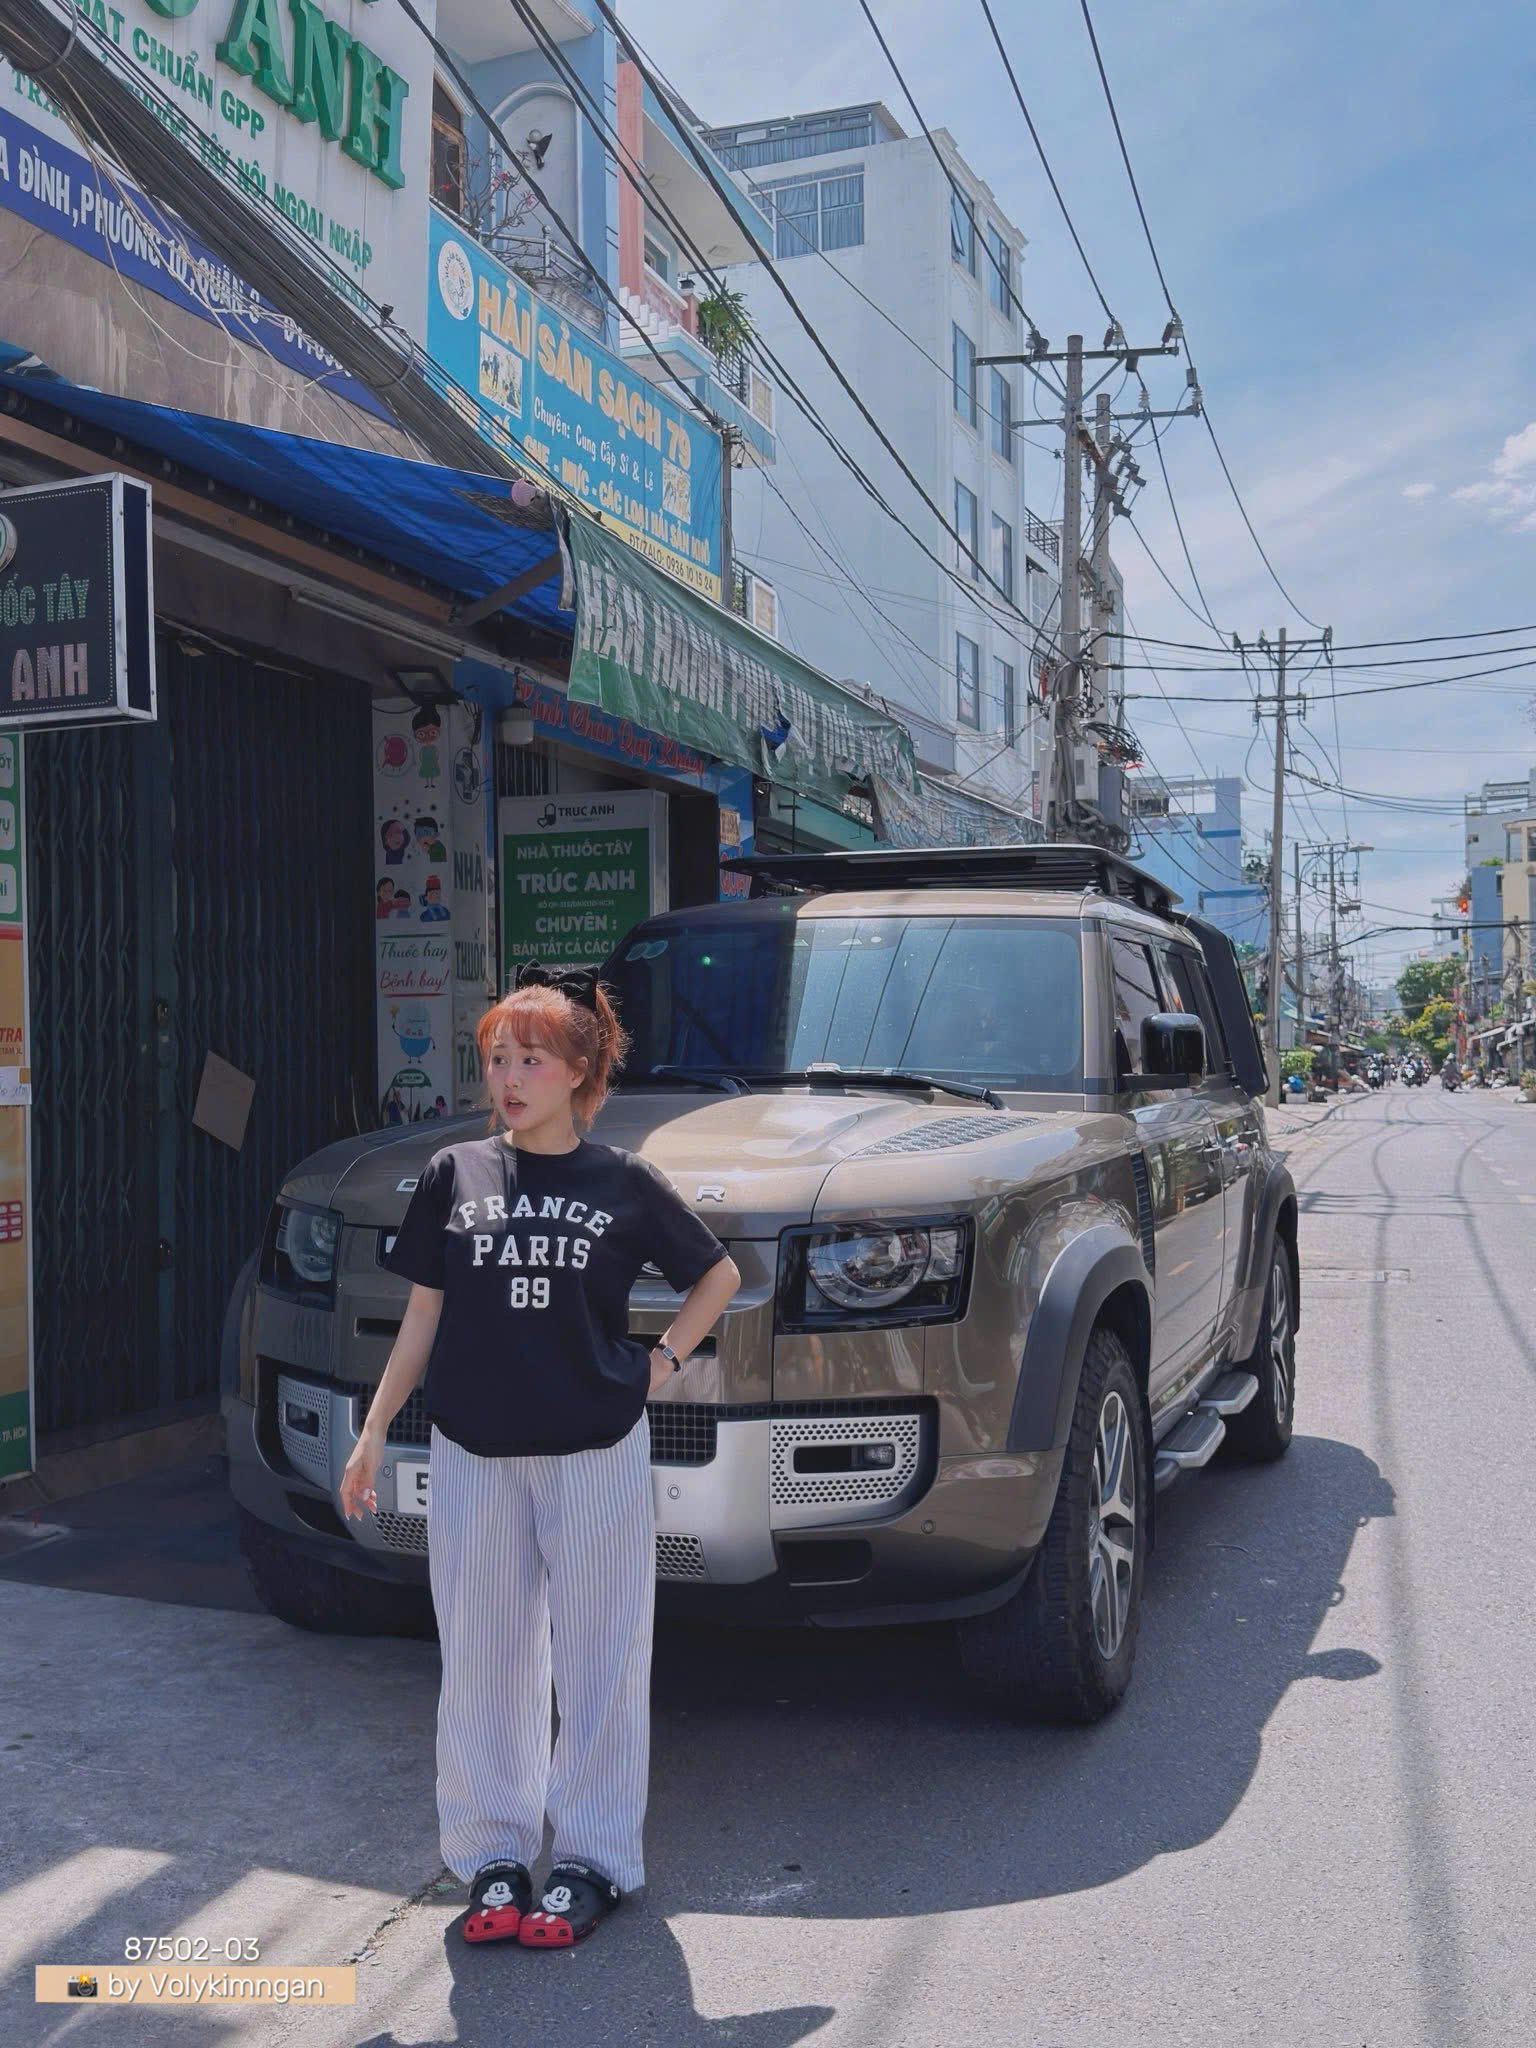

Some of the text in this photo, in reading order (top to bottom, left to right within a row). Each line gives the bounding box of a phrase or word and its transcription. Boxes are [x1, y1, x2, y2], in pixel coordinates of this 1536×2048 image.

[132, 27, 213, 110] CHUẨN
[220, 89, 265, 140] GPP
[214, 0, 409, 190] ANH
[273, 182, 323, 242] NGOẠI
[329, 218, 373, 273] NHẬP
[478, 275, 692, 471] HẢI SẢN SẠCH 79
[534, 396, 571, 439] Chuyên:
[575, 424, 597, 462] Cung
[600, 440, 617, 473] Cấp
[599, 480, 622, 515] CÁC
[624, 495, 649, 532] LOẠI
[666, 556, 684, 577] 0936
[705, 578, 713, 593] 24
[43, 573, 90, 624] TÂY
[11, 643, 89, 701] ANH
[590, 804, 615, 816] ANH
[454, 843, 484, 893] NHÀ
[517, 837, 633, 860] NHÀ THUỐC TÂY
[517, 867, 635, 894] TRÚC ANH
[379, 940, 449, 964] Thuốc hay
[454, 927, 487, 981] THUỐC
[512, 940, 539, 956] BÁN
[542, 937, 562, 956] TẤT
[564, 936, 582, 955] CẢ
[584, 937, 609, 954] CÁC
[379, 970, 415, 992] Bệnh
[458, 1194, 614, 1238] FRANCE
[472, 1234, 592, 1270] PARIS
[510, 1277, 551, 1309] 89
